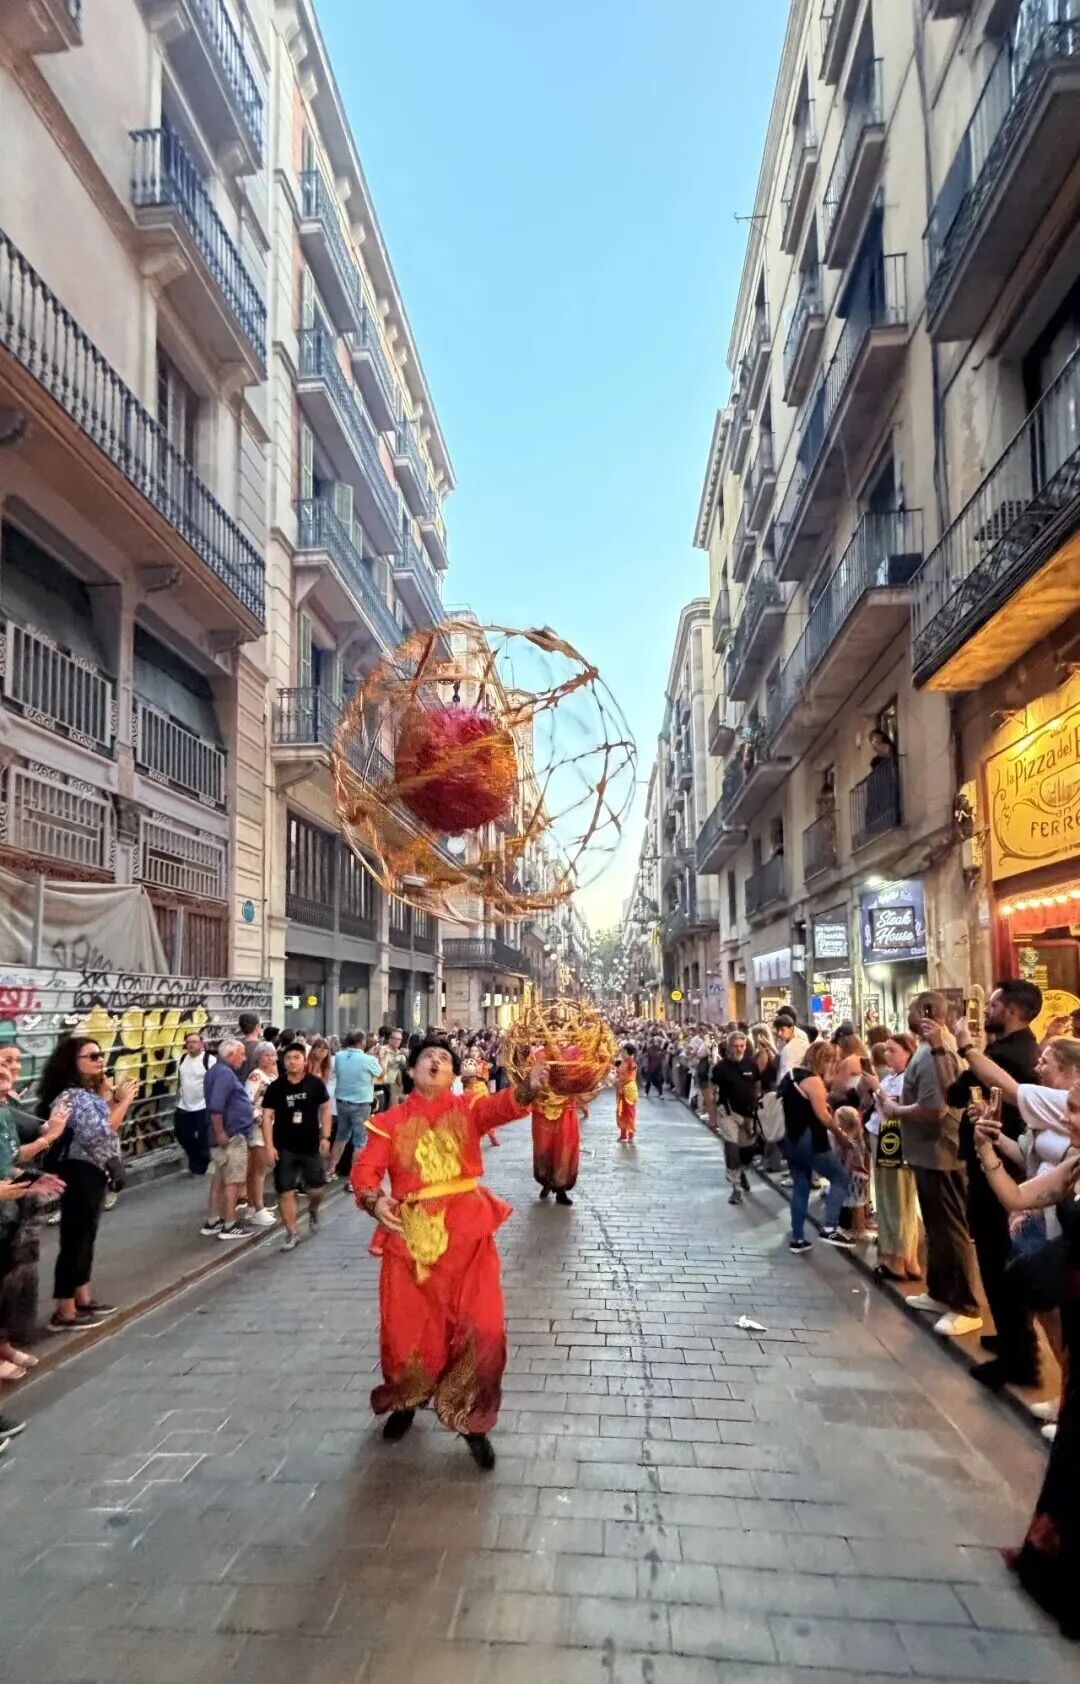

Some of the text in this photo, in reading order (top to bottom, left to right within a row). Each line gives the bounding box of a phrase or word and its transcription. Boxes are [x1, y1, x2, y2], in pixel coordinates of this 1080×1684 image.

[1057, 732, 1073, 758] del
[876, 910, 912, 928] Steak
[875, 926, 914, 945] House
